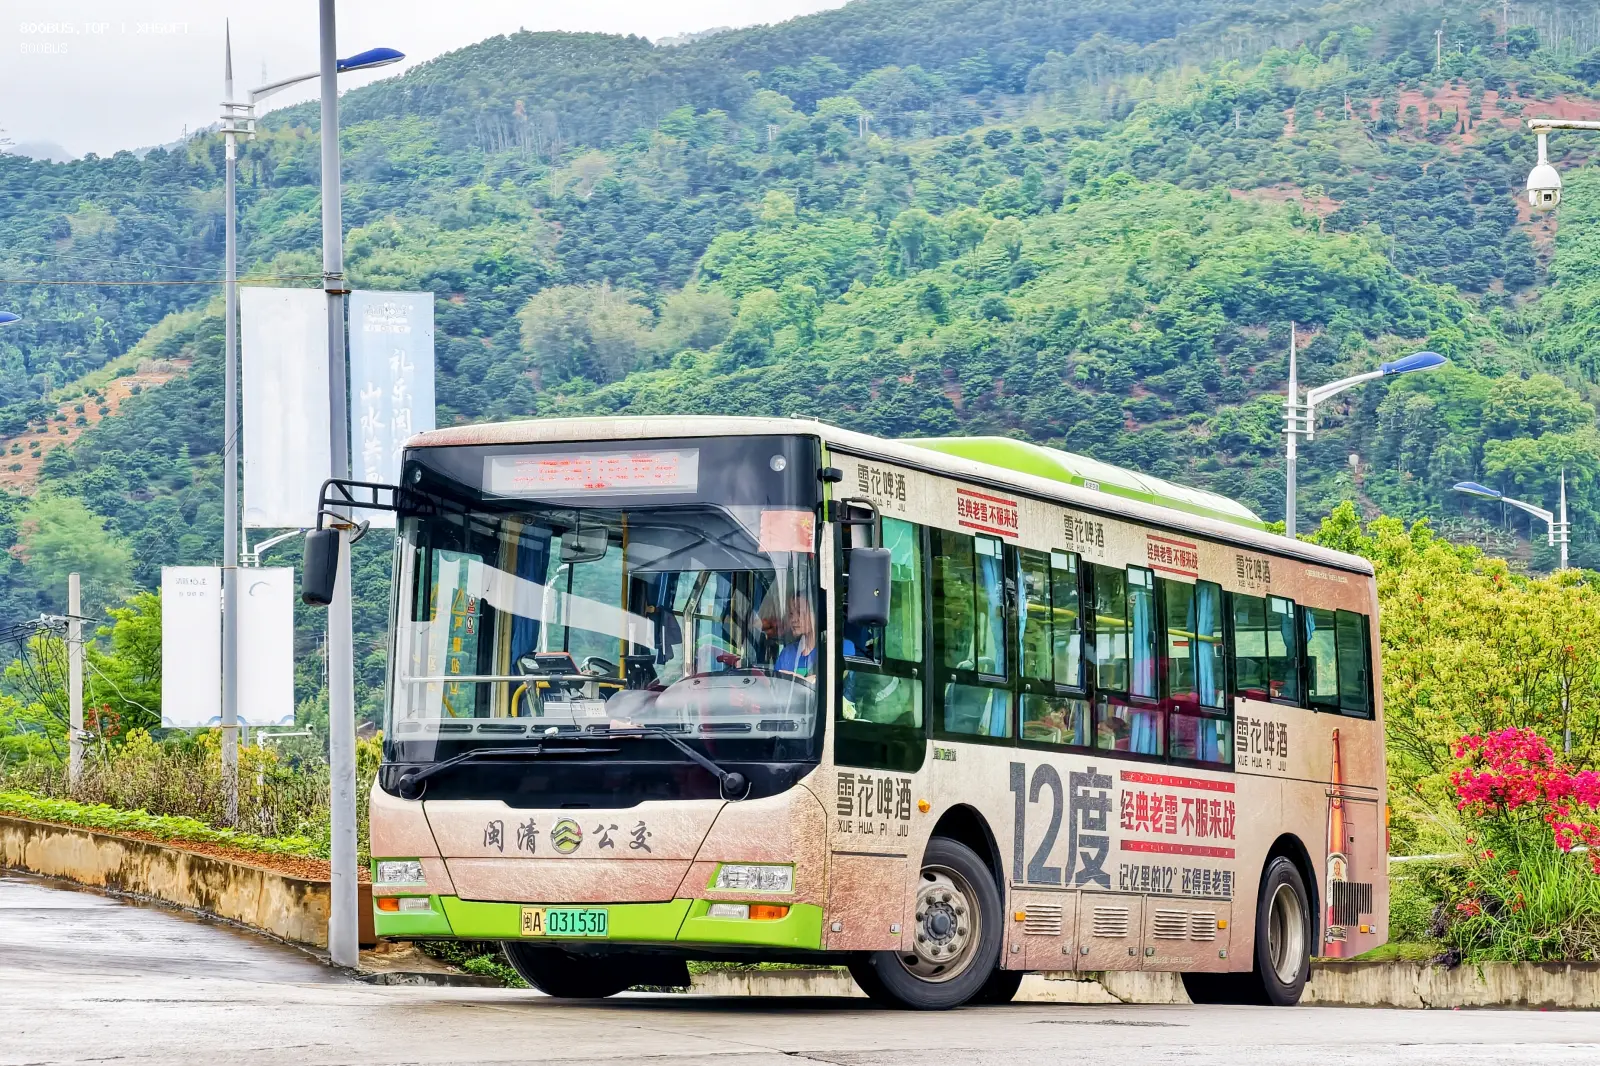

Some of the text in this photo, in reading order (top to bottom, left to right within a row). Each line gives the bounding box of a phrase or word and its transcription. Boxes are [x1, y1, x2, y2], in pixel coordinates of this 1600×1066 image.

[857, 464, 906, 501] 雪花啤酒
[957, 497, 988, 522] 经典老雪
[1064, 514, 1105, 548] 雪花啤酒
[1146, 543, 1173, 564] 经典老雪
[1235, 554, 1271, 583] 雪花啤酒
[1236, 715, 1288, 758] 雪花啤酒
[1237, 754, 1248, 767] XUE
[1251, 756, 1263, 768] HUA
[1266, 758, 1272, 770] PI
[836, 772, 911, 821] 雪花啤酒
[837, 819, 909, 837] XUE HUA PI JIU
[1009, 761, 1113, 889] 12度
[1120, 789, 1236, 840] 经典老雪 不服来战
[483, 818, 653, 855] 闽清 公交
[549, 912, 606, 933] 03153D
